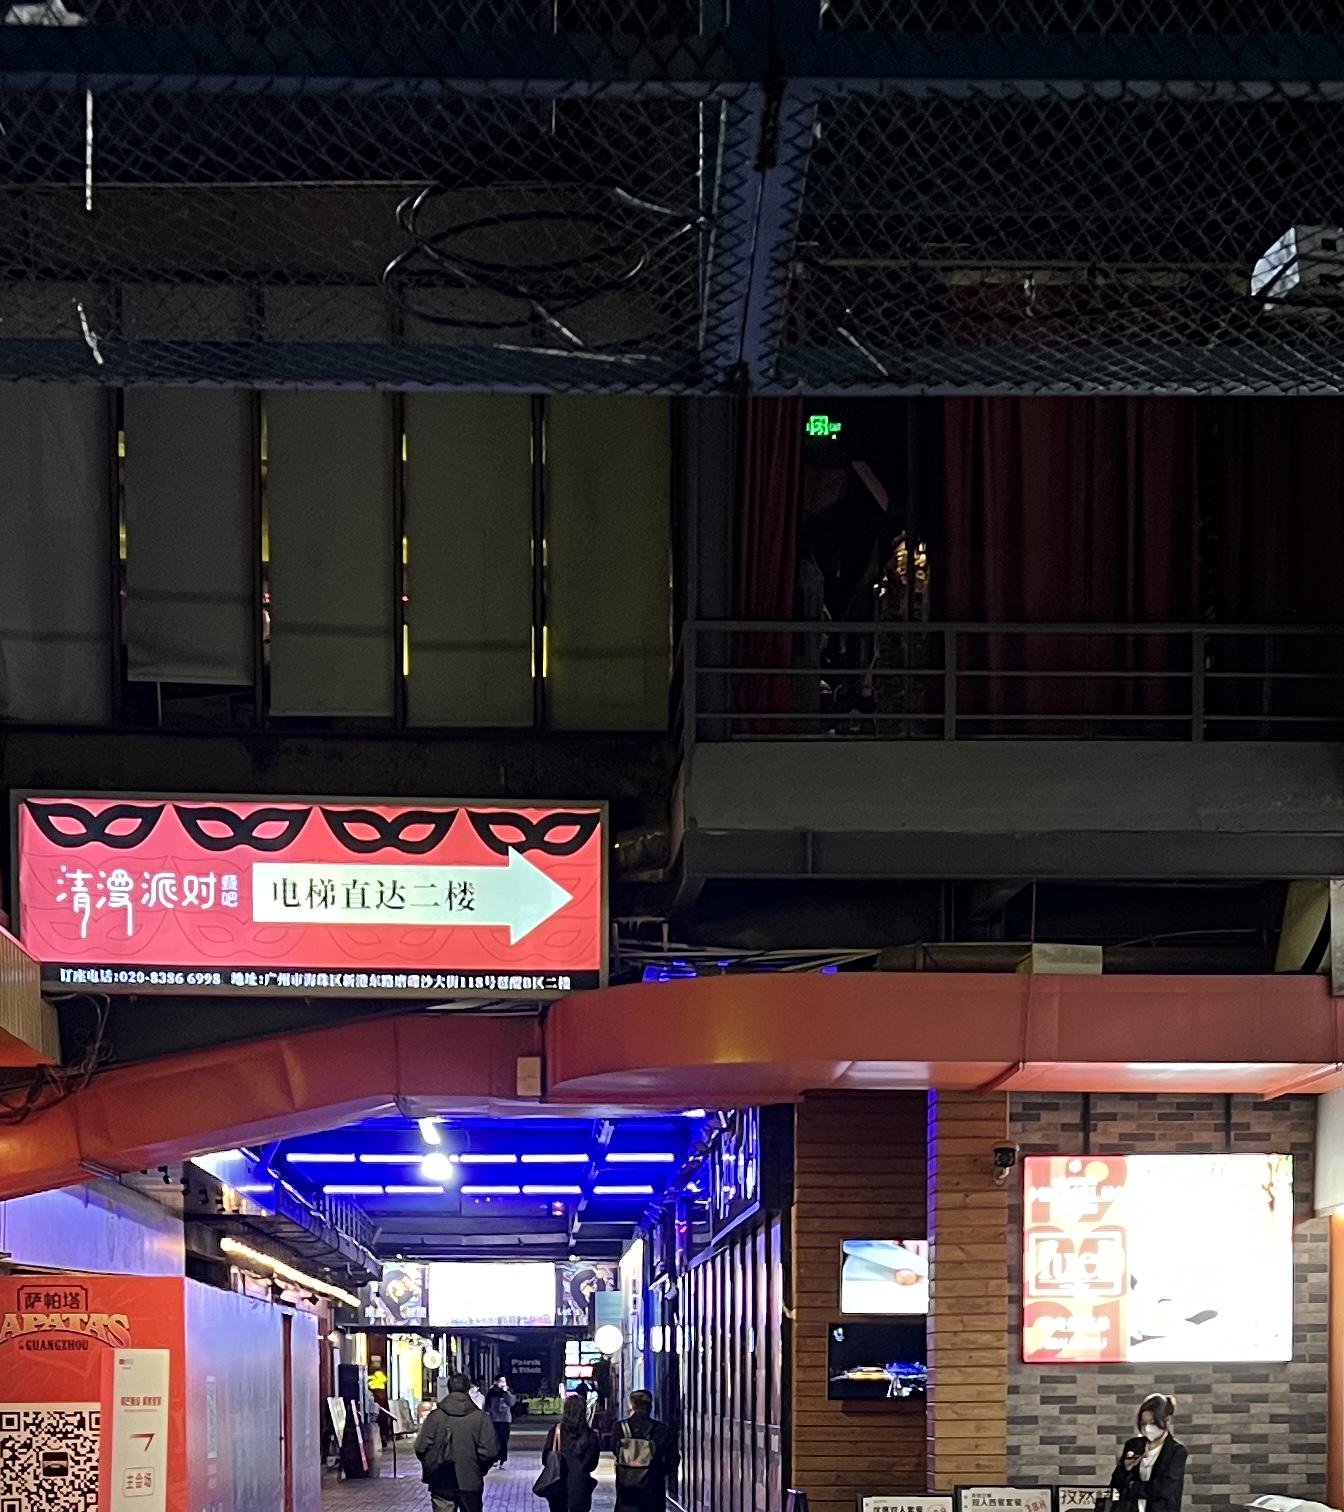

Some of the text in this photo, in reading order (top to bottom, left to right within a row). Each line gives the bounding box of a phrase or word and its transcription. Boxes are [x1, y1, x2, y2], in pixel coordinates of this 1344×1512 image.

[273, 877, 476, 912] 电梯直达二楼
[186, 971, 221, 985] 6998
[24, 1291, 81, 1310] 萨帕塔
[25, 1340, 89, 1351] GUANGZHOU
